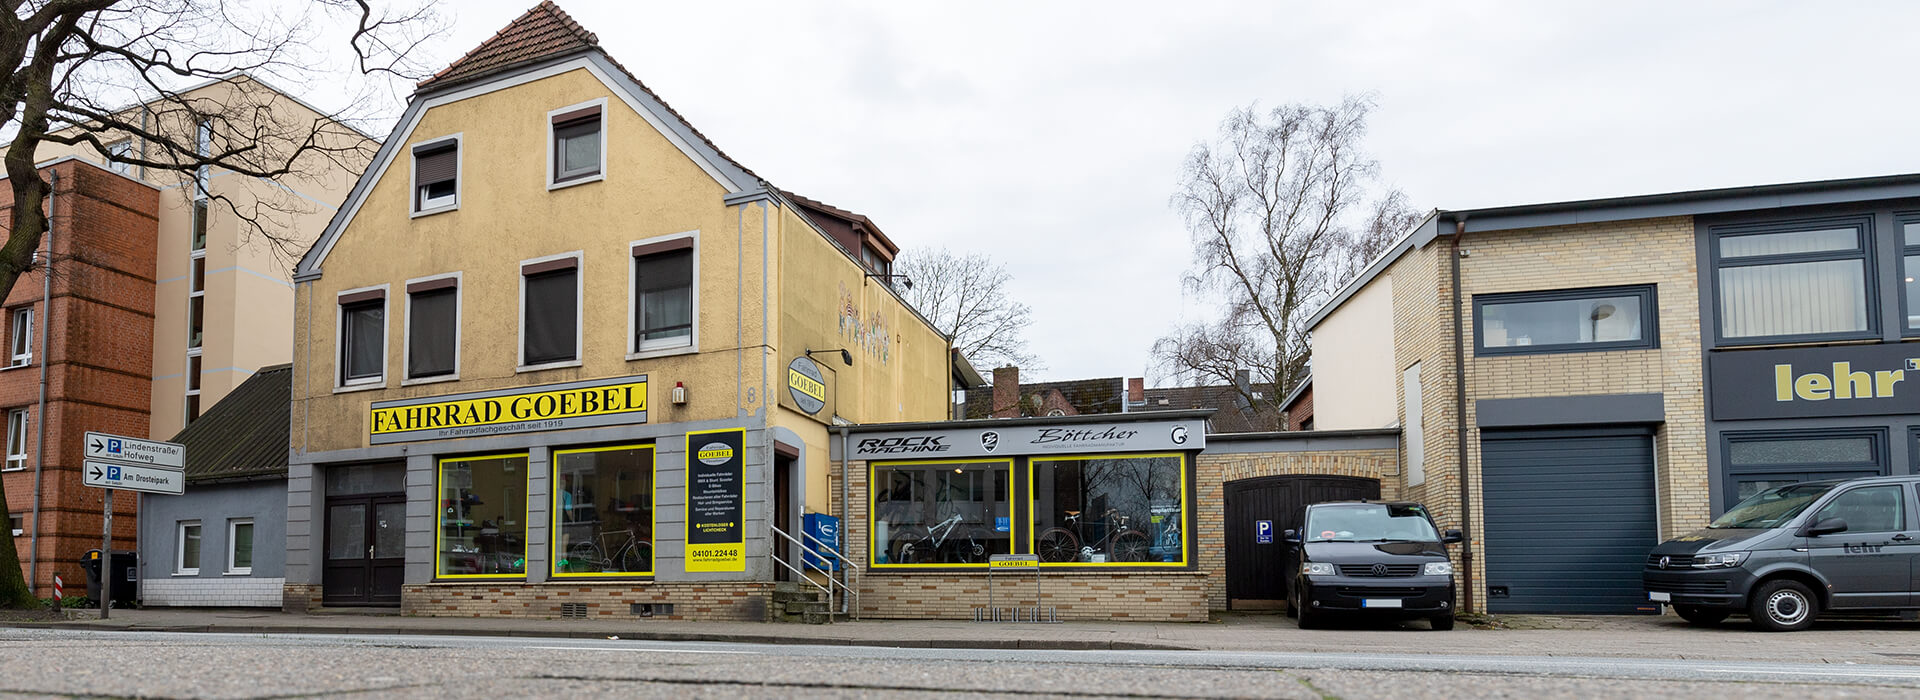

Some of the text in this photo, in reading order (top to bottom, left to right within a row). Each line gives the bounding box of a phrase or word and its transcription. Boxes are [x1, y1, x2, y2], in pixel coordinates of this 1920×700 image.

[790, 373, 824, 399] GOEBEL
[1775, 361, 1904, 401] lehr
[747, 386, 756, 403] 8
[373, 387, 644, 432] FAHRRAD GOEBEL
[439, 420, 564, 437] Ihr Fahrradfachgeschäft seit 1919
[1030, 426, 1138, 444] Böttcher
[124, 441, 179, 455] Lindenstraße/
[857, 436, 947, 448] ROCK
[699, 450, 732, 458] GOEBEL
[857, 445, 951, 454] MACHINE
[124, 451, 154, 463] Hofweg
[123, 473, 133, 481] Am
[136, 474, 169, 485] Drosteipark
[1260, 522, 1269, 535] P
[1843, 542, 1883, 554] lehr
